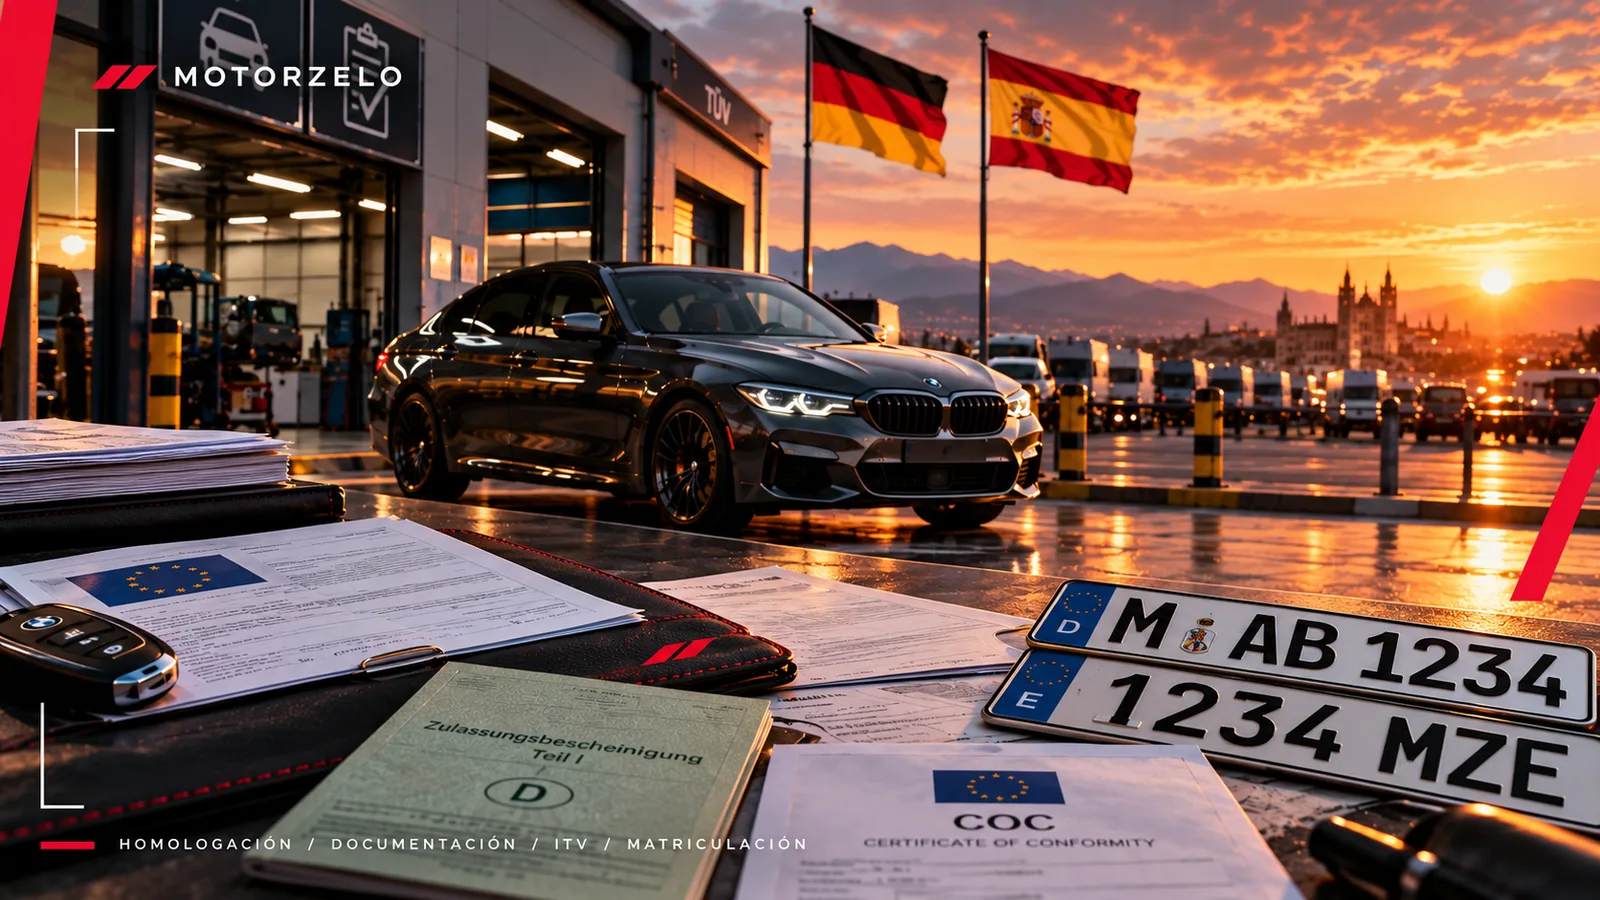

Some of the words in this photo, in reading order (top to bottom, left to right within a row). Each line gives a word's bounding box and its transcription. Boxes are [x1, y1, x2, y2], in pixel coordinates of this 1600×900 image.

[704, 83, 731, 126] TÜV
[1056, 618, 1081, 634] D
[1107, 597, 1179, 650] M
[1228, 613, 1340, 671] AB
[1359, 630, 1569, 708] 1234
[1015, 690, 1044, 710] E
[423, 720, 704, 766] Zulassungsbescheinigung
[1092, 672, 1343, 763] 1234
[1377, 714, 1571, 808] MZE
[532, 748, 571, 764] Teil
[509, 782, 548, 803] D
[953, 813, 1056, 832] COC
[863, 837, 987, 849] CERTIFICATE
[994, 838, 1016, 849] OF
[1026, 837, 1156, 849] CONFORMITY
